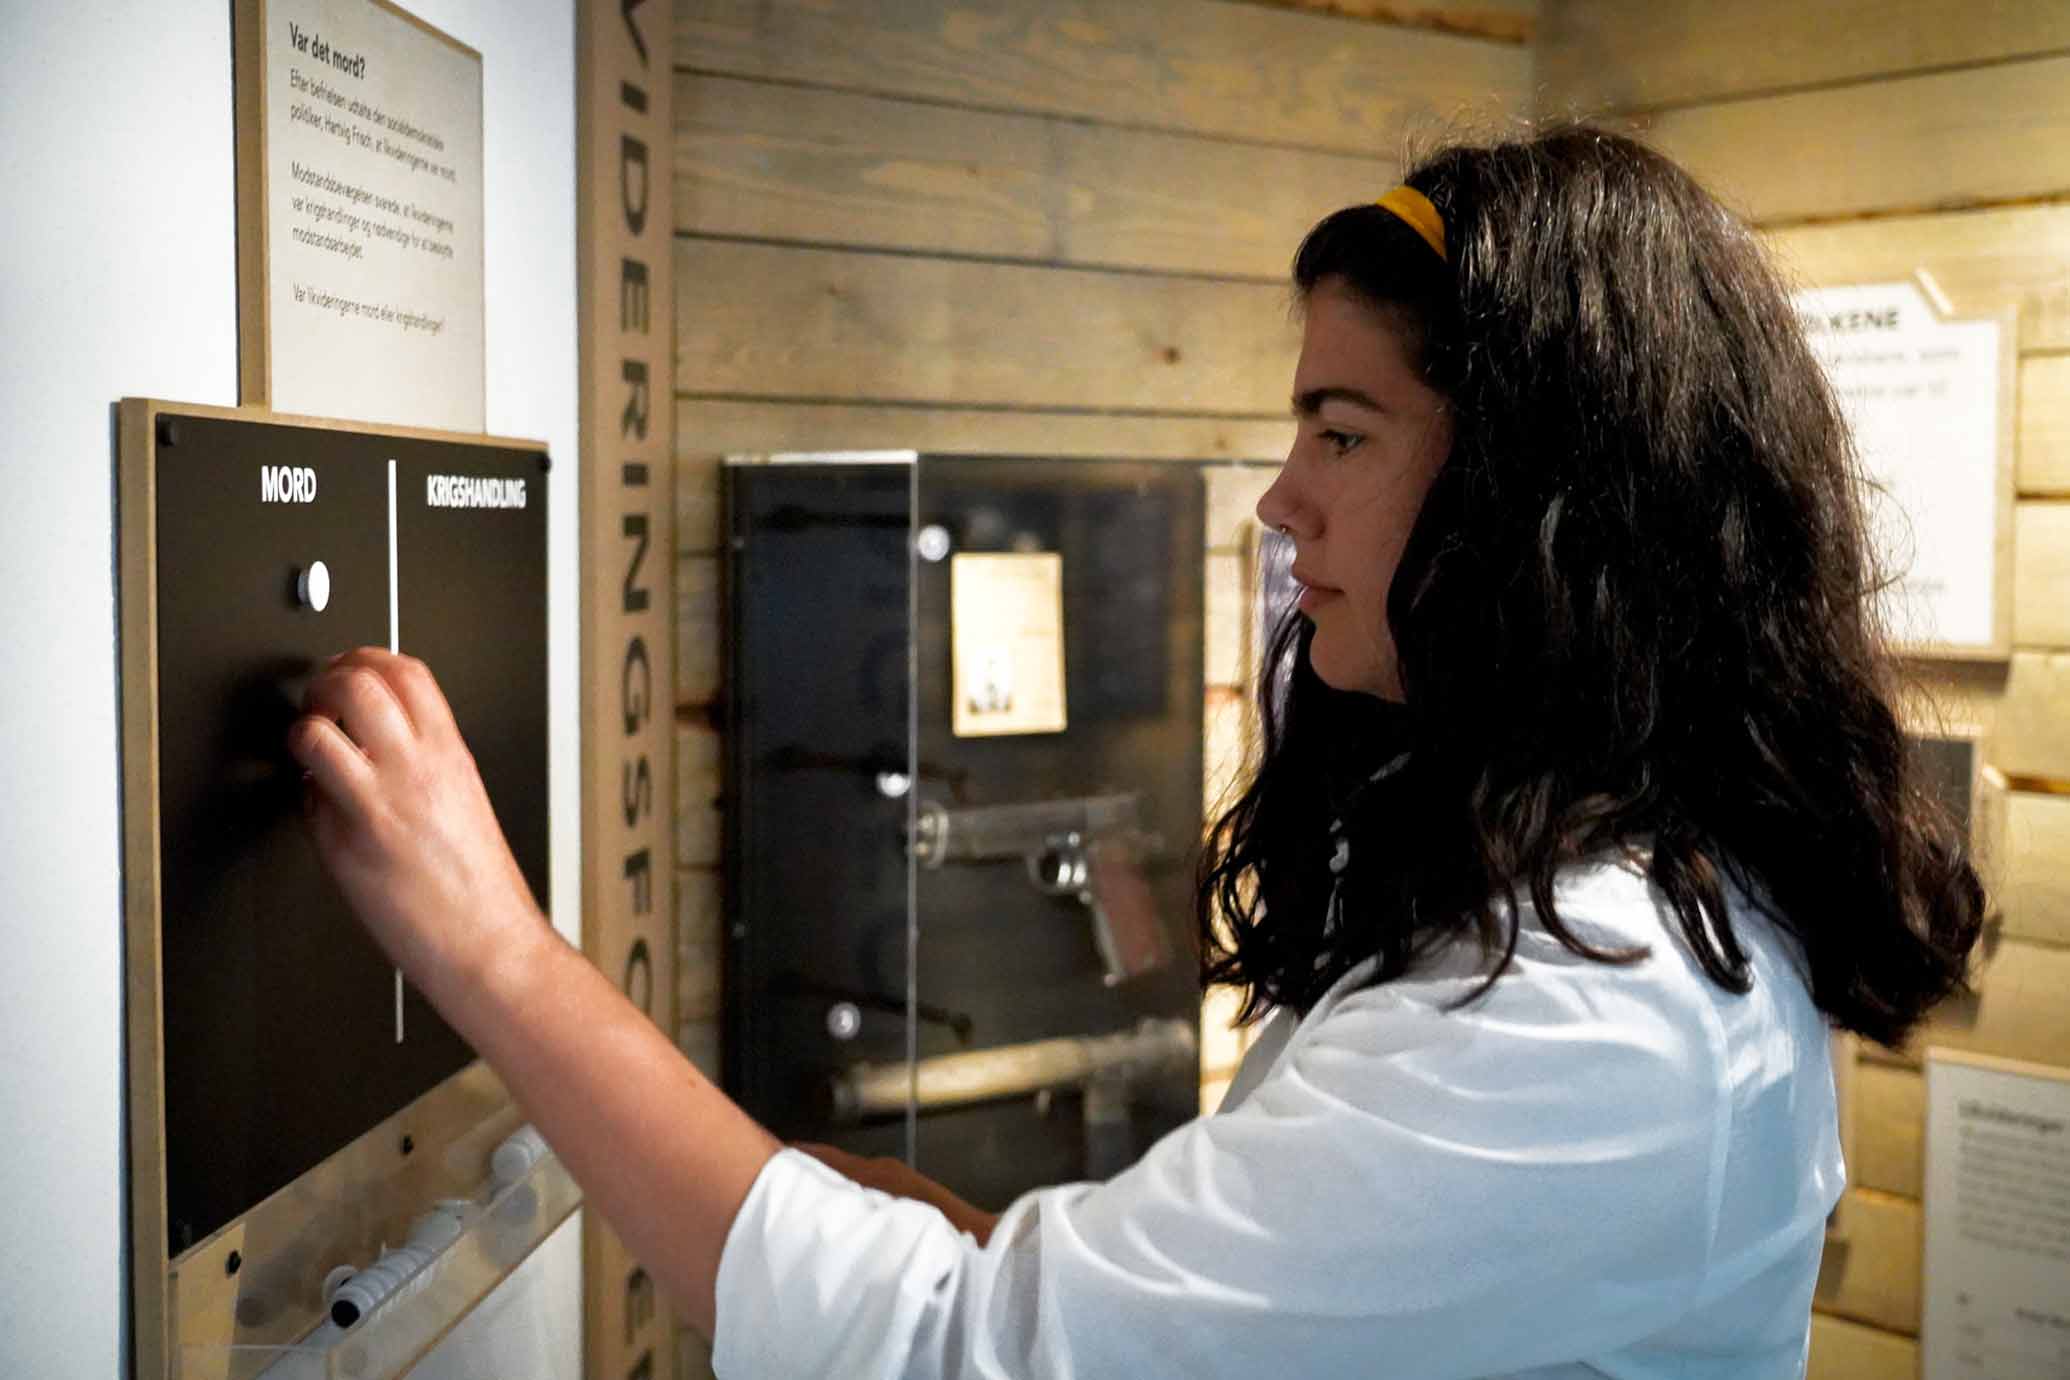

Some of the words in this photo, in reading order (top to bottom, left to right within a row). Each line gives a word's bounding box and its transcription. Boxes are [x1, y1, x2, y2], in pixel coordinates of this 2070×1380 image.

[289, 21, 309, 53] Var
[312, 33, 330, 64] det
[333, 50, 366, 80] mord?
[261, 465, 317, 504] MORD
[427, 474, 527, 509] KRIGSHANDLING
